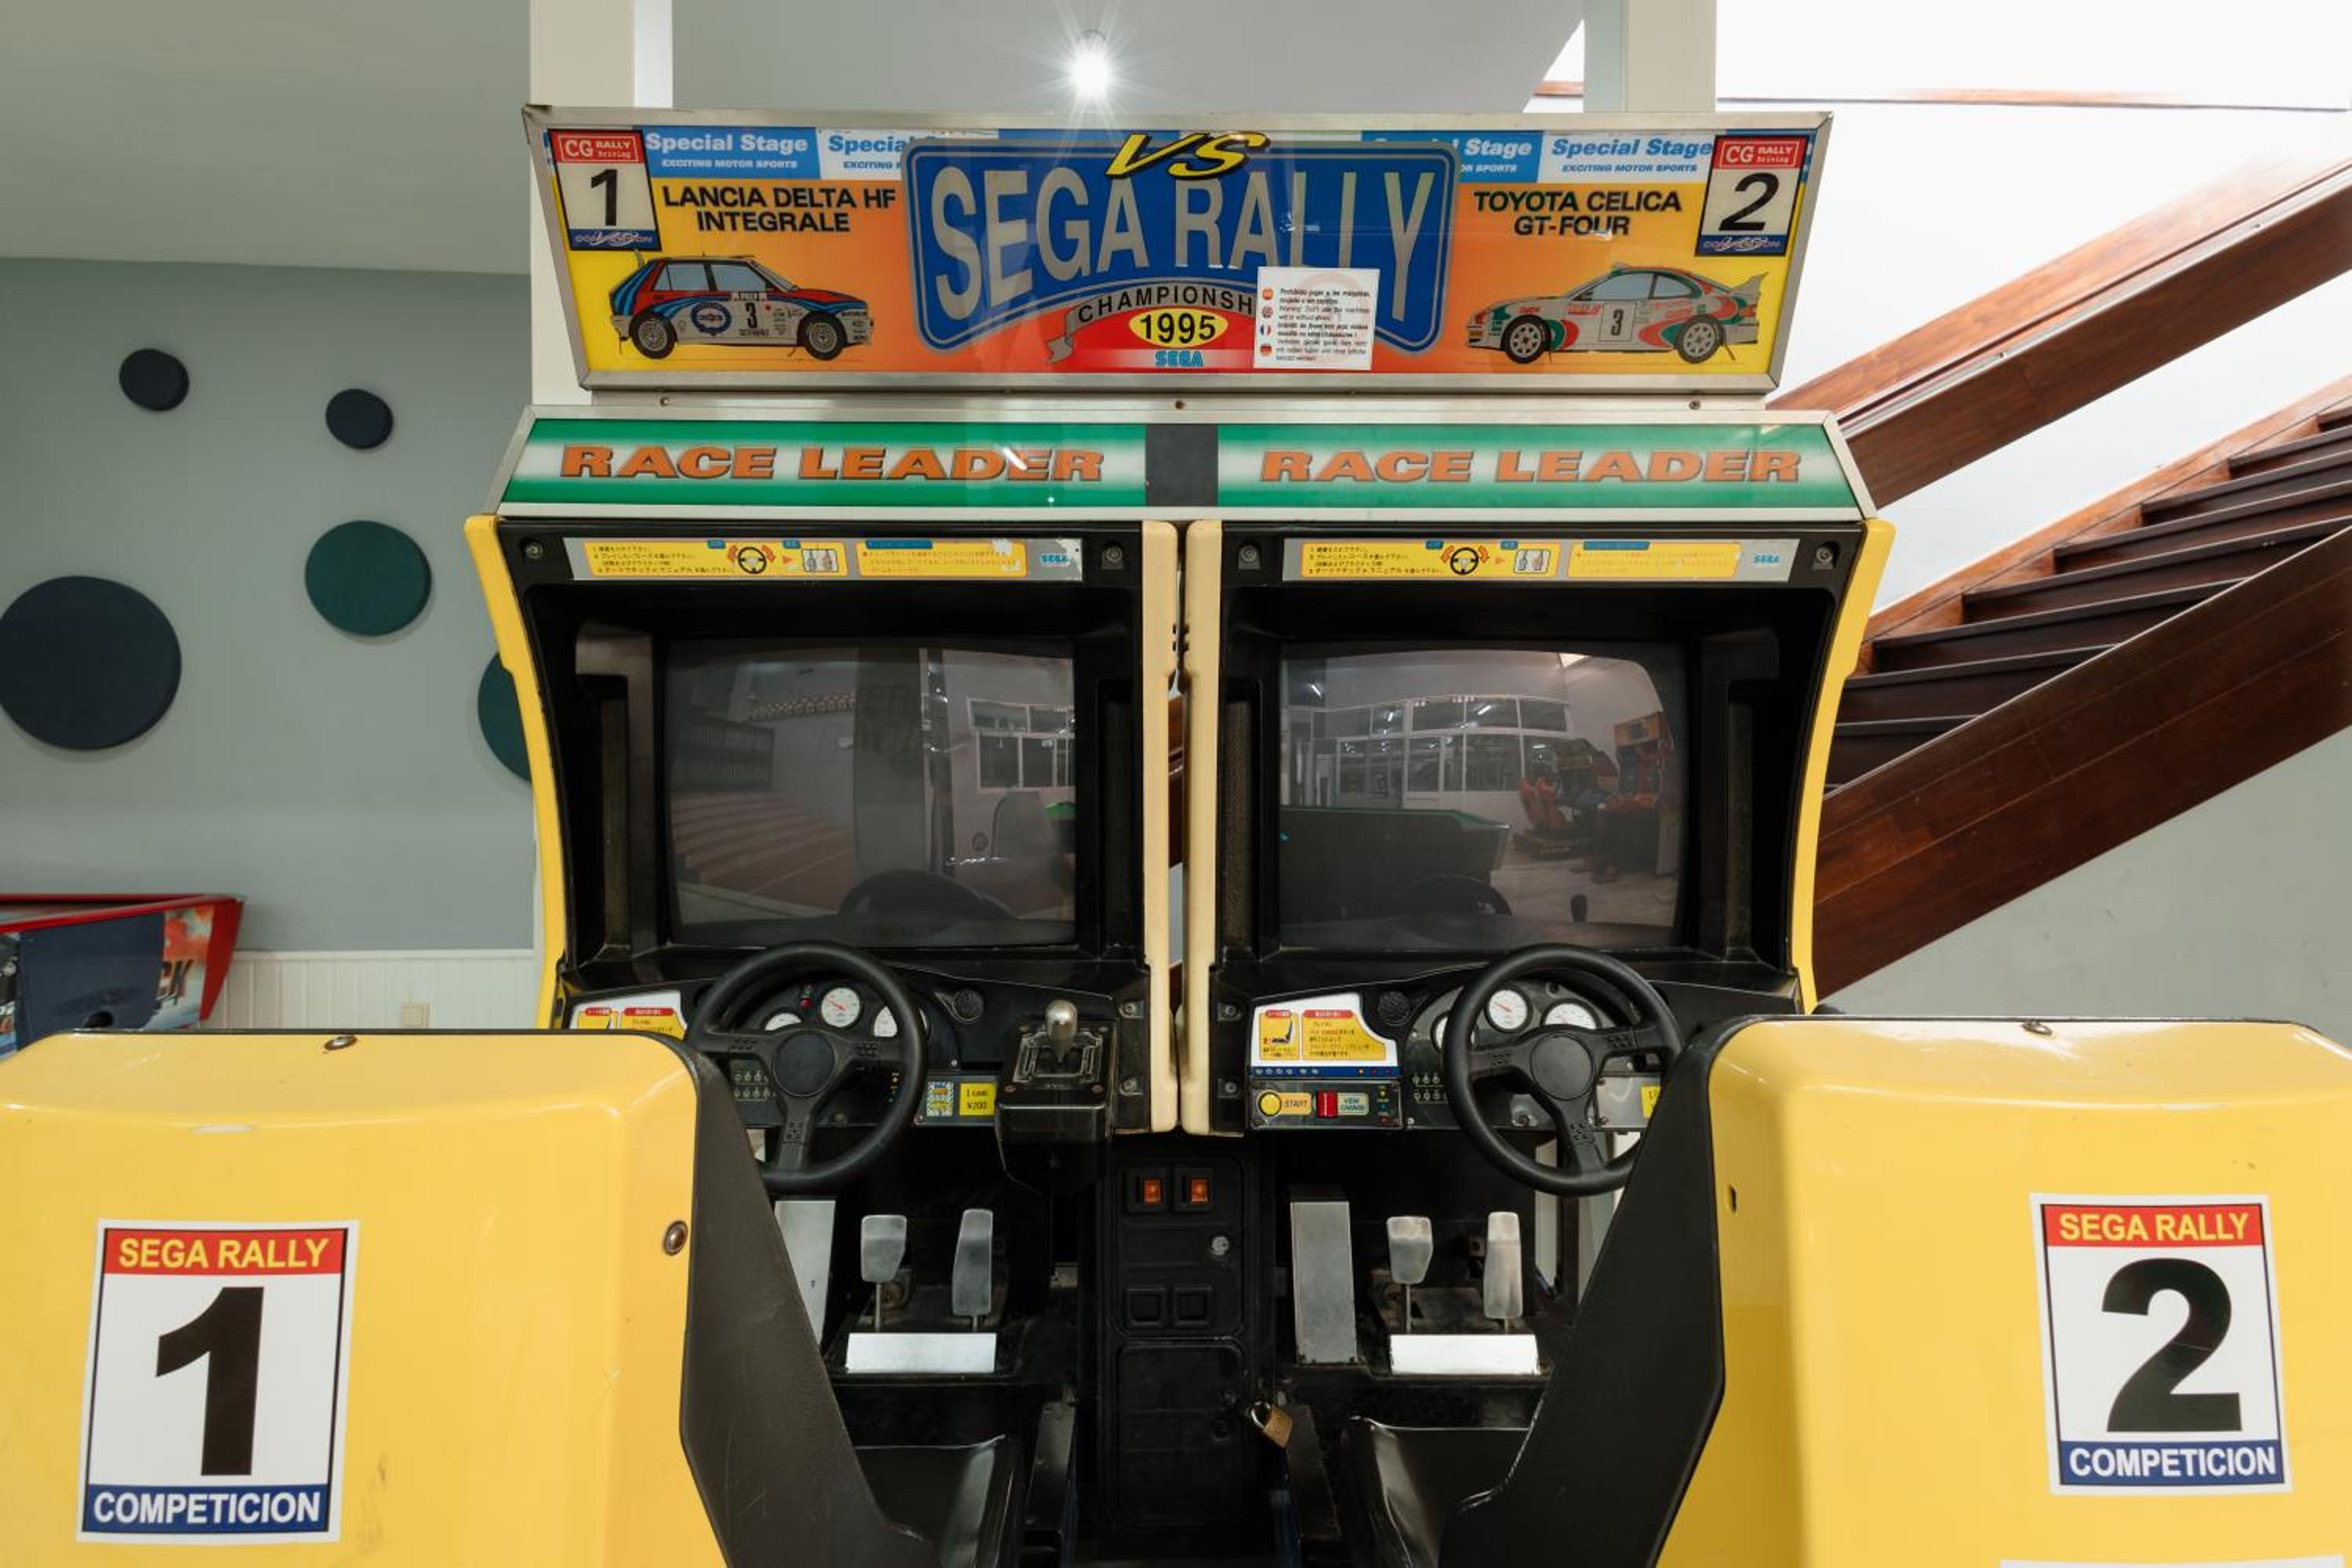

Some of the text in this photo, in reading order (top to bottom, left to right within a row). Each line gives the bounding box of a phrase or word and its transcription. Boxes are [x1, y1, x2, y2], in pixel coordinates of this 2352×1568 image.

[565, 140, 593, 157] CG
[645, 132, 808, 155] Special Stage
[829, 135, 914, 155] Specia
[1104, 132, 1270, 180] VS
[1465, 138, 1531, 158] Stage
[1552, 139, 1713, 158] Special Stage
[1726, 146, 1755, 163] CG
[662, 159, 712, 168] EXCITING
[715, 159, 753, 169] MOTOR
[843, 161, 893, 169] EXCITING
[1562, 164, 1697, 172] EXCITING MOTOR SPORTS
[591, 169, 618, 227] 1
[662, 186, 896, 209] LANCIA DELTA HF
[1474, 191, 1682, 212] TOYOTA CELICA
[1719, 172, 1780, 231] 2
[698, 210, 851, 232] INTEGRALE
[1514, 216, 1631, 236] GT-FOUR
[931, 165, 1149, 321] SEGA
[745, 302, 758, 328] 3
[1078, 285, 1253, 323] CHAMPIONSH
[1140, 312, 1216, 344] 1995
[1610, 309, 1624, 336] 3
[1155, 350, 1204, 368] SEGA
[560, 444, 1105, 481] RACE LEADER
[1260, 450, 1802, 484] RACE LEADER
[1283, 1099, 1307, 1108] START
[2060, 1213, 2249, 1241] SEGA RALLY
[119, 1238, 329, 1269] SEGA RALLY
[2102, 1257, 2243, 1432] 2
[156, 1287, 265, 1476] 1
[2069, 1446, 2276, 1477] COMPETICION
[93, 1491, 321, 1524] COMPETICION
